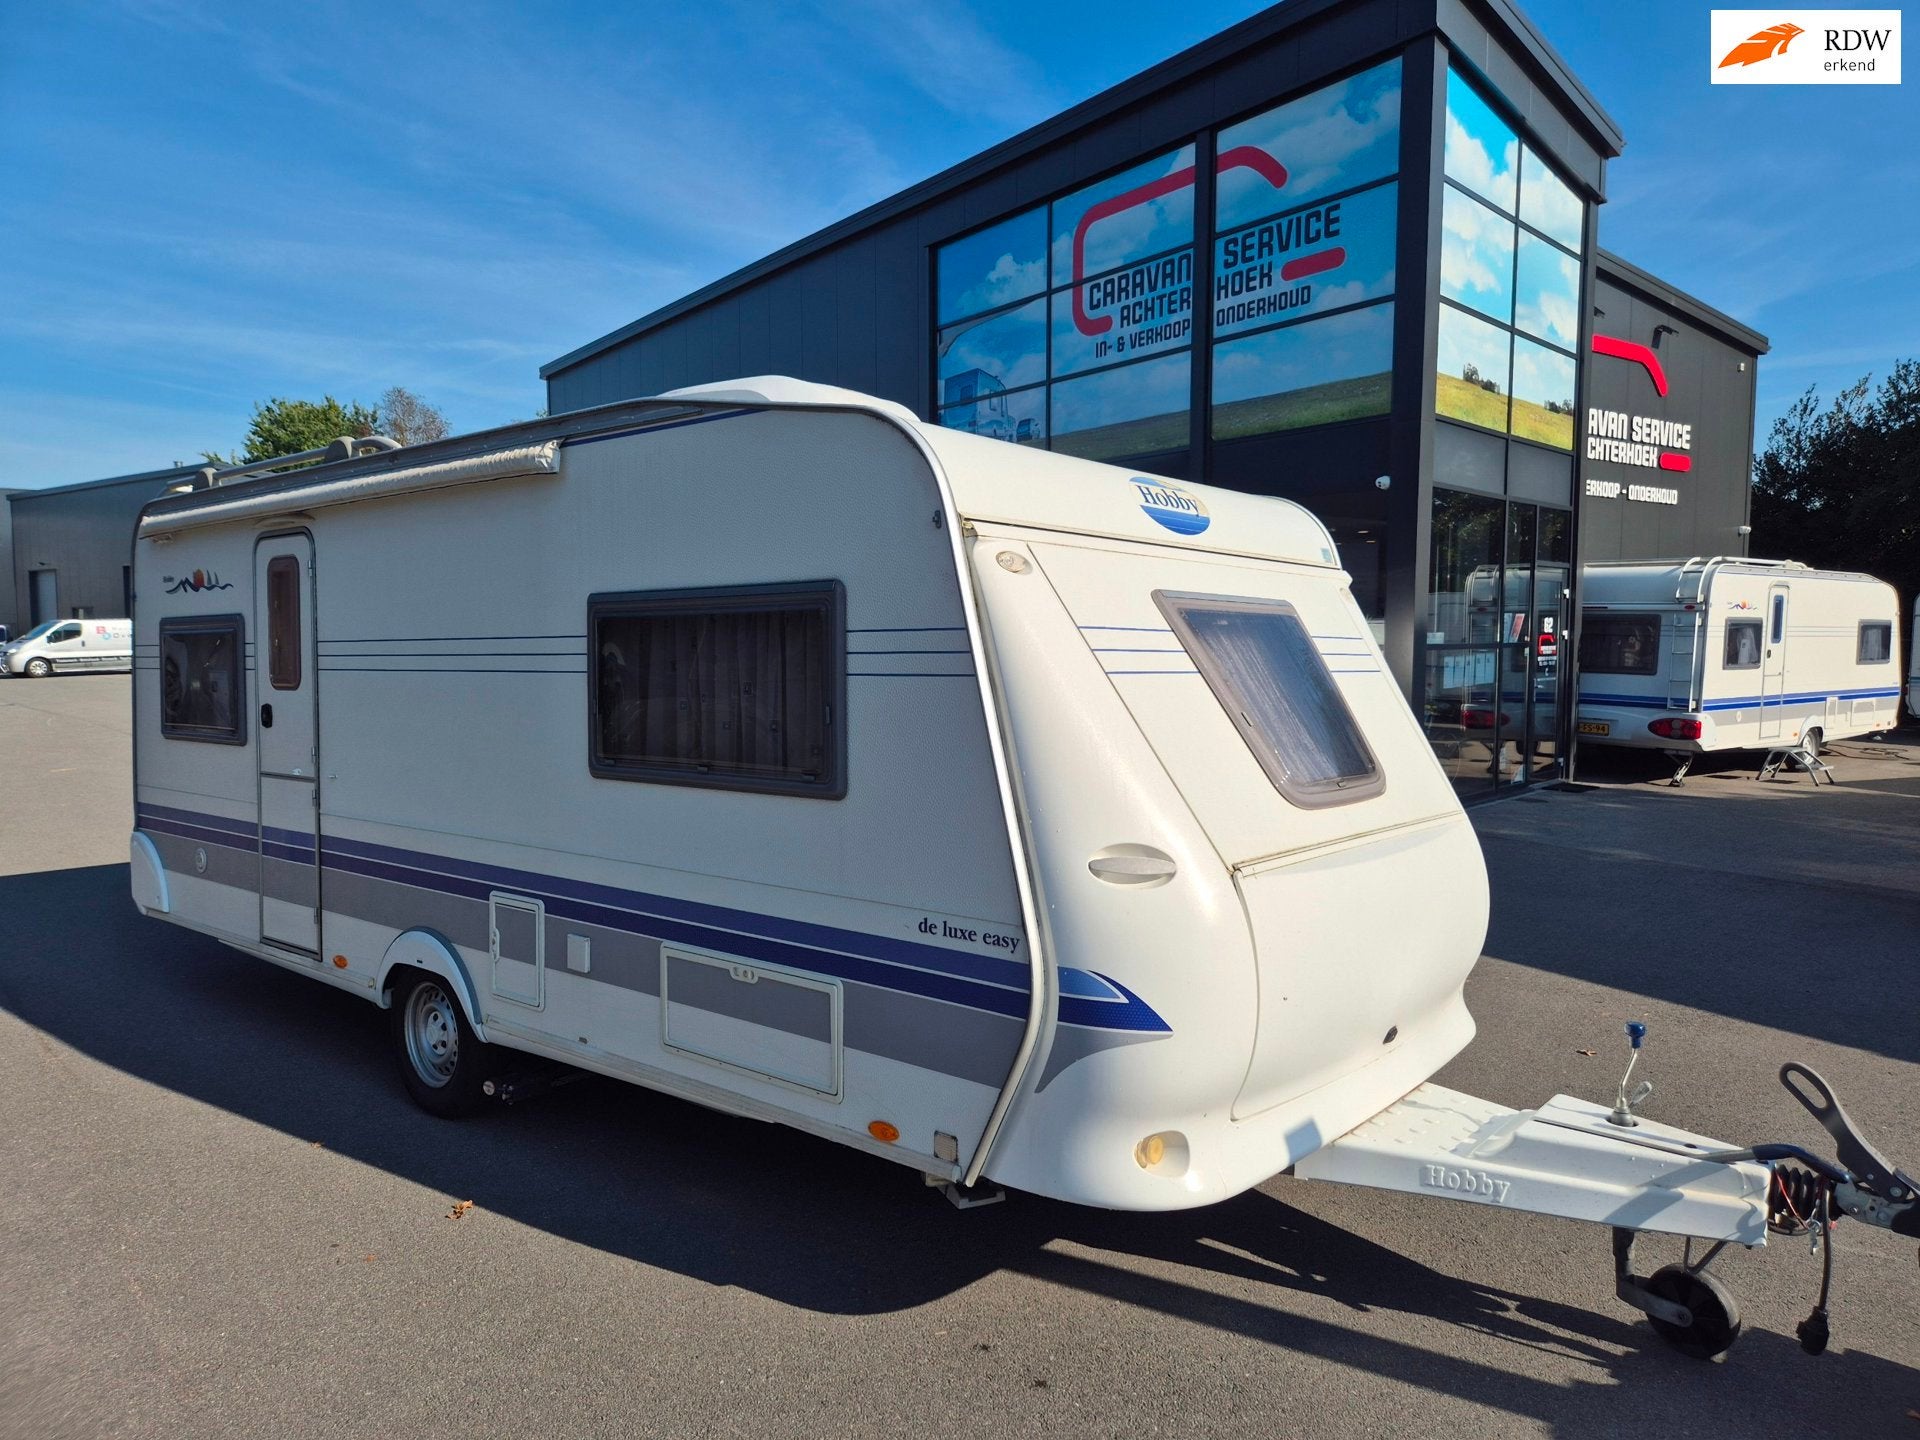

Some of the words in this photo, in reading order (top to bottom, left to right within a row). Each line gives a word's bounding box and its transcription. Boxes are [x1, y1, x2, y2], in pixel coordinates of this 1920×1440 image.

[1089, 252, 1192, 311] CARAVAN
[1223, 203, 1341, 270] SERVICE
[1120, 287, 1191, 328] ACHTER
[1216, 261, 1273, 301] HOEK
[1117, 335, 1126, 352] &
[1130, 318, 1191, 350] VERKOOP
[1216, 285, 1312, 327] ONDERHOUD
[1632, 415, 1692, 450] SERVICE
[1135, 484, 1199, 517] Hobby
[1628, 484, 1678, 505] ONDERHOUD
[918, 917, 938, 935] de
[942, 920, 977, 942] luxe
[982, 932, 1020, 954] easy
[1423, 1164, 1511, 1203] Hobby
